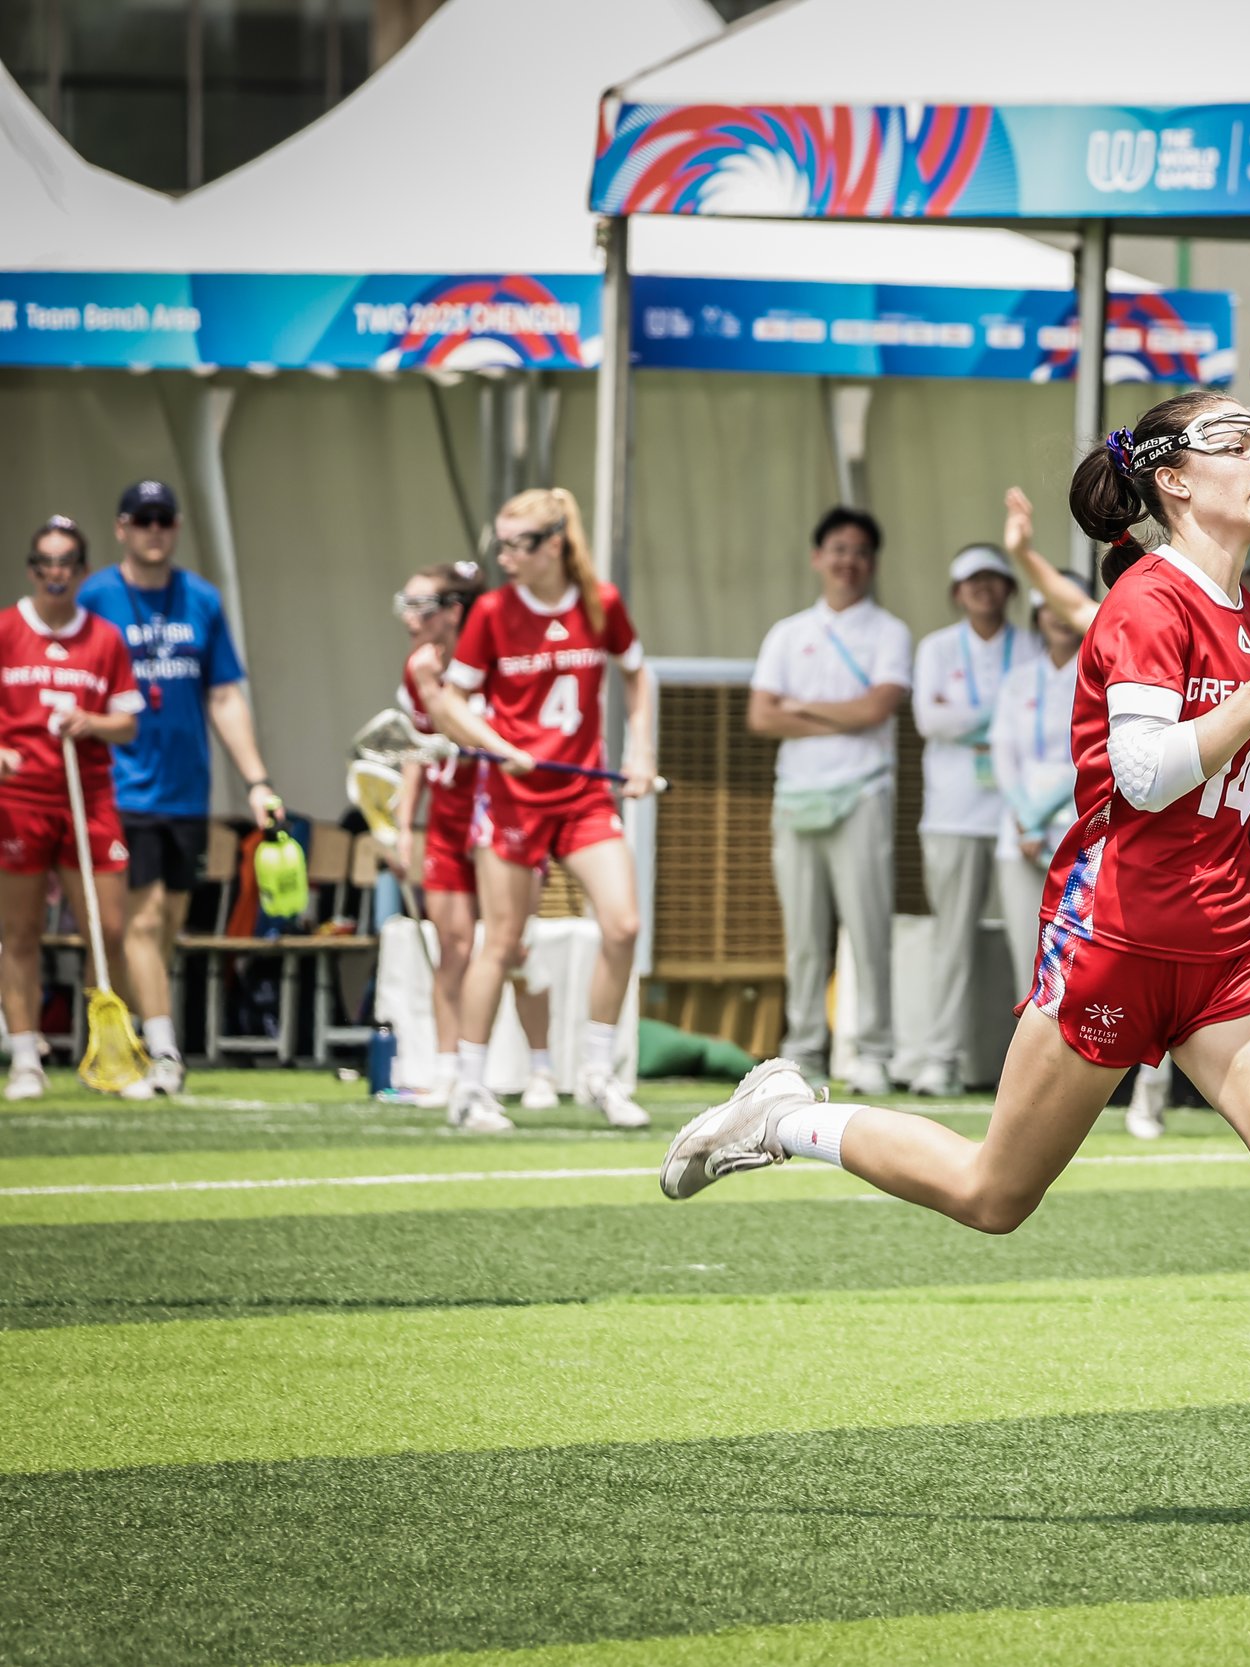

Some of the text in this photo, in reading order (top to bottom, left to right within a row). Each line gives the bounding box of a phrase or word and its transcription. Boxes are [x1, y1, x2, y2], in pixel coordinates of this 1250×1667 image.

[1148, 441, 1173, 460] GAIT
[1186, 677, 1247, 704] GRE
[39, 688, 77, 736] 7
[538, 673, 584, 737] 4
[1079, 1032, 1116, 1045] LACROSSE
[1080, 1025, 1118, 1038] BRITISH
